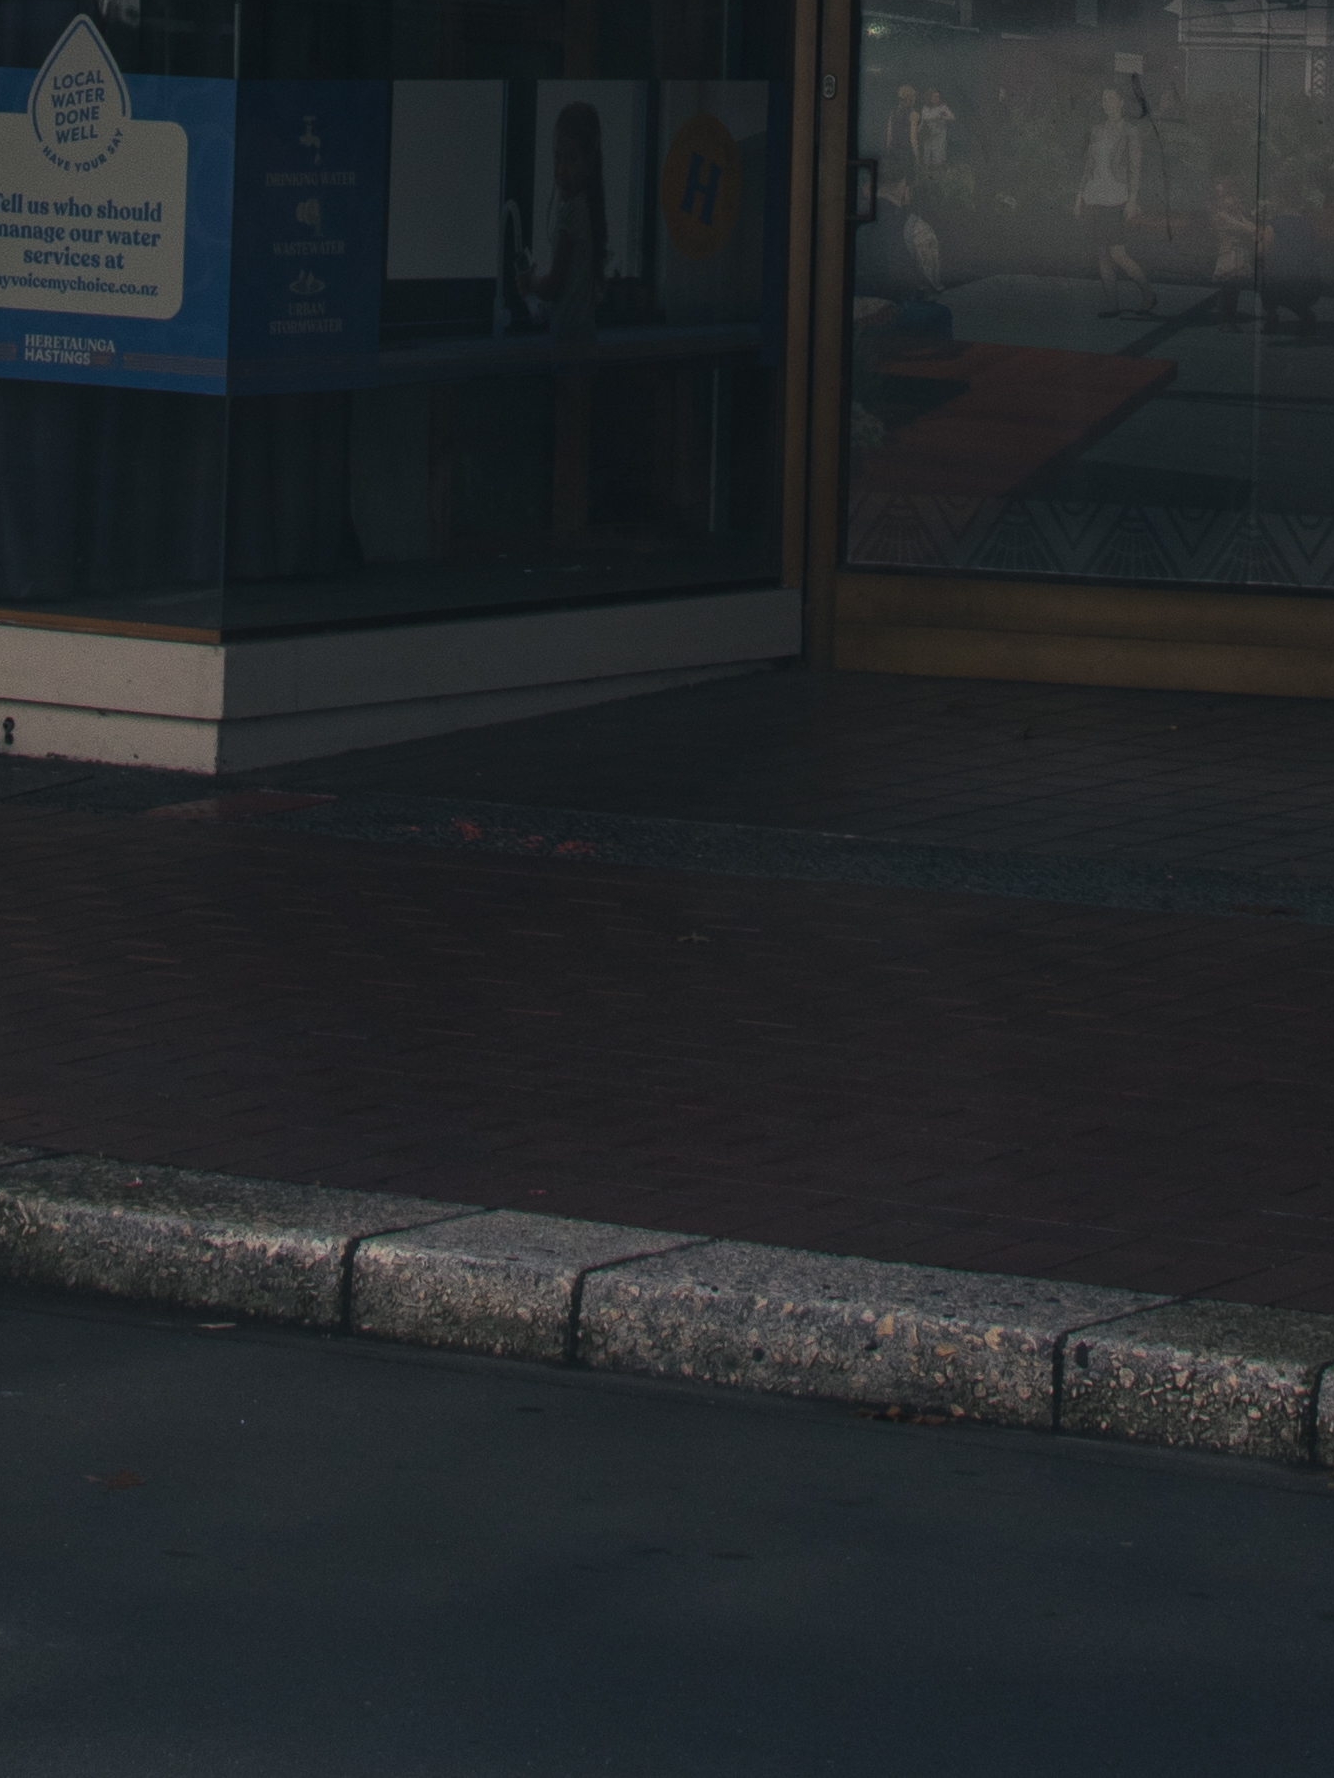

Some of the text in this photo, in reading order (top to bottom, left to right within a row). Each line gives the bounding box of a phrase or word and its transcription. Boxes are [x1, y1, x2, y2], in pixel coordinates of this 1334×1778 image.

[53, 69, 105, 90] LOCAL
[51, 87, 105, 109] WATER
[55, 105, 100, 126] DONE
[55, 123, 98, 144] WELL
[42, 128, 124, 172] HAVE YOUR SAY
[320, 171, 356, 186] WATER
[679, 151, 723, 227] H
[27, 200, 50, 215] us
[53, 196, 93, 218] who
[96, 199, 163, 223] should
[69, 227, 104, 244] our
[106, 229, 162, 248] water
[23, 246, 125, 270] services at
[23, 333, 117, 354] HERETAUNGA
[23, 348, 92, 366] HASTINGS
